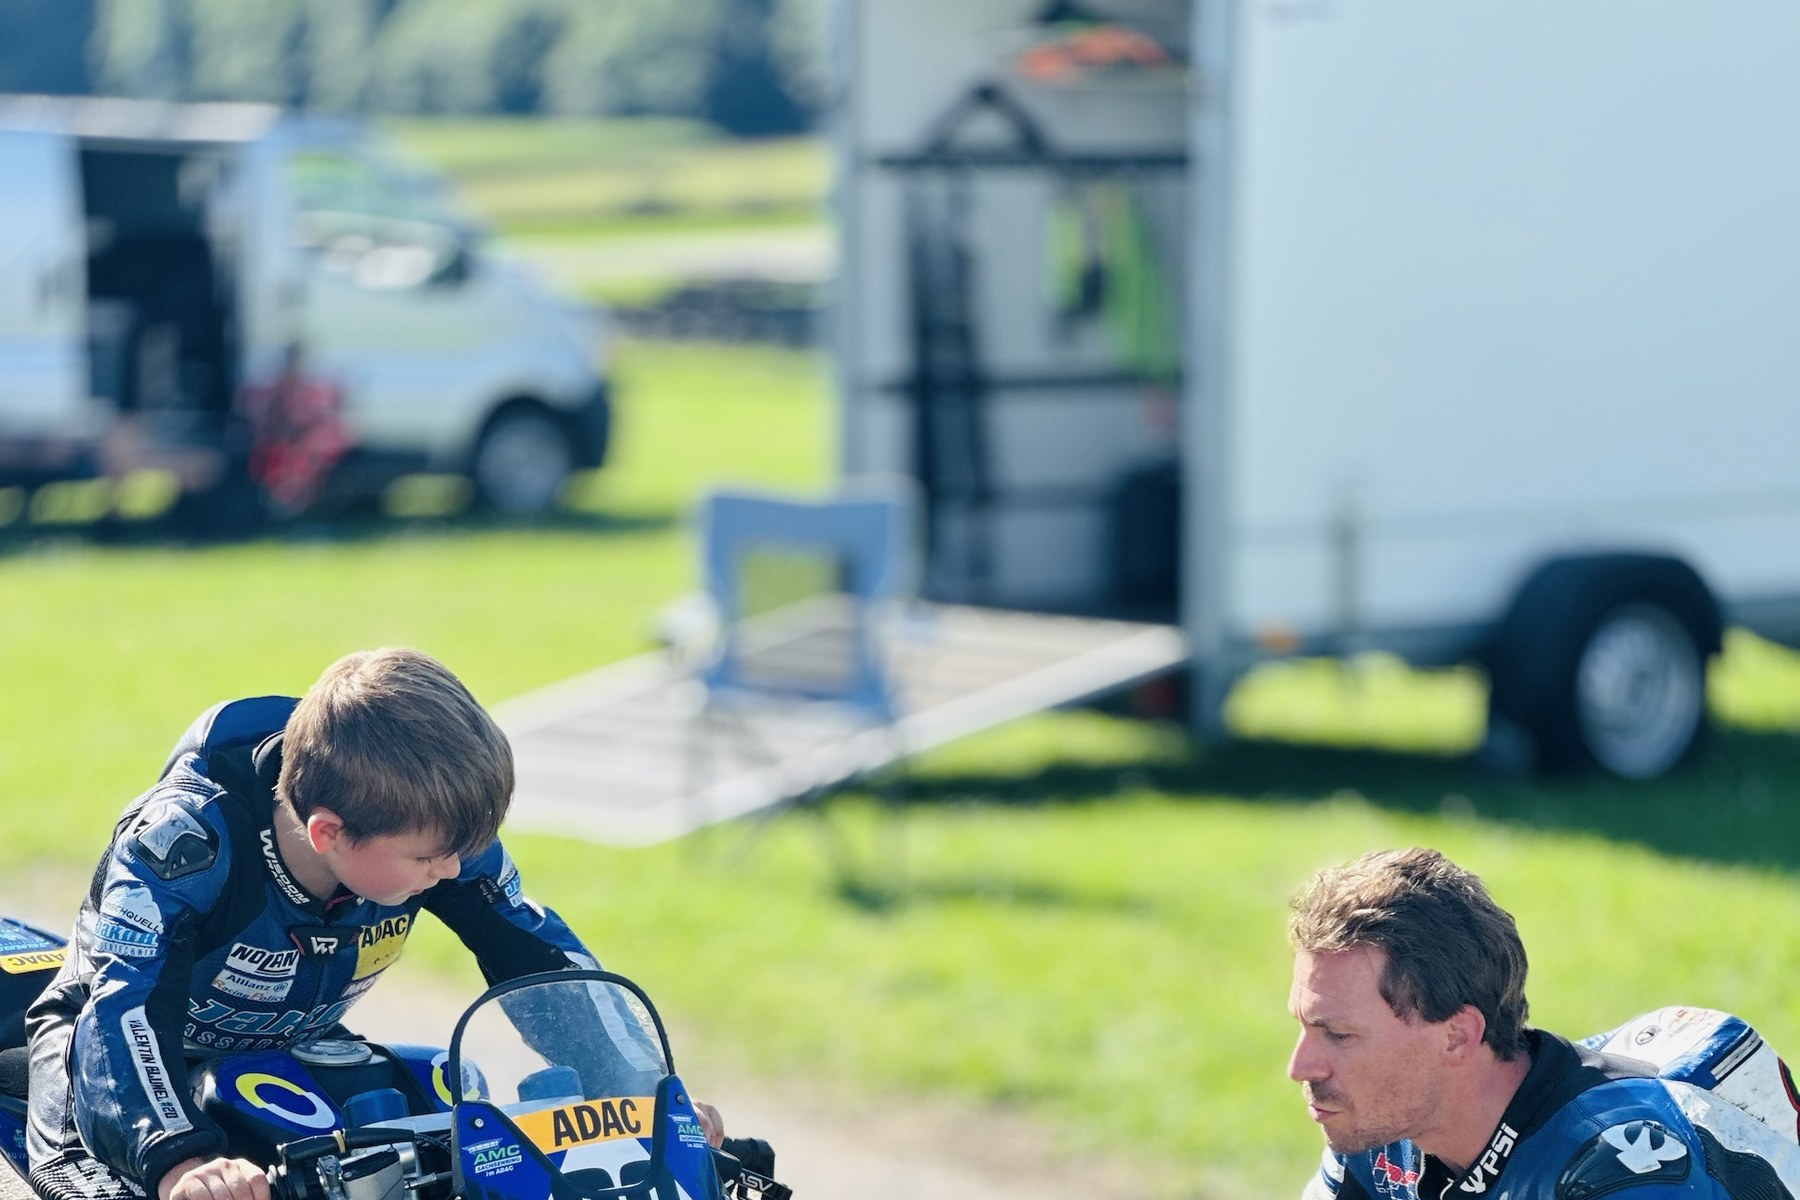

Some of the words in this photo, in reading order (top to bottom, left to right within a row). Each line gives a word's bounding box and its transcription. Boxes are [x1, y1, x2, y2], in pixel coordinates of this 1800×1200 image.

[361, 914, 410, 948] ADAC
[230, 945, 298, 976] NOLAN
[227, 974, 271, 991] Allianz
[129, 1018, 156, 1064] VALENTIN
[159, 1100, 179, 1119] #20
[552, 1098, 642, 1147] ADAC
[474, 1144, 520, 1166] AMC
